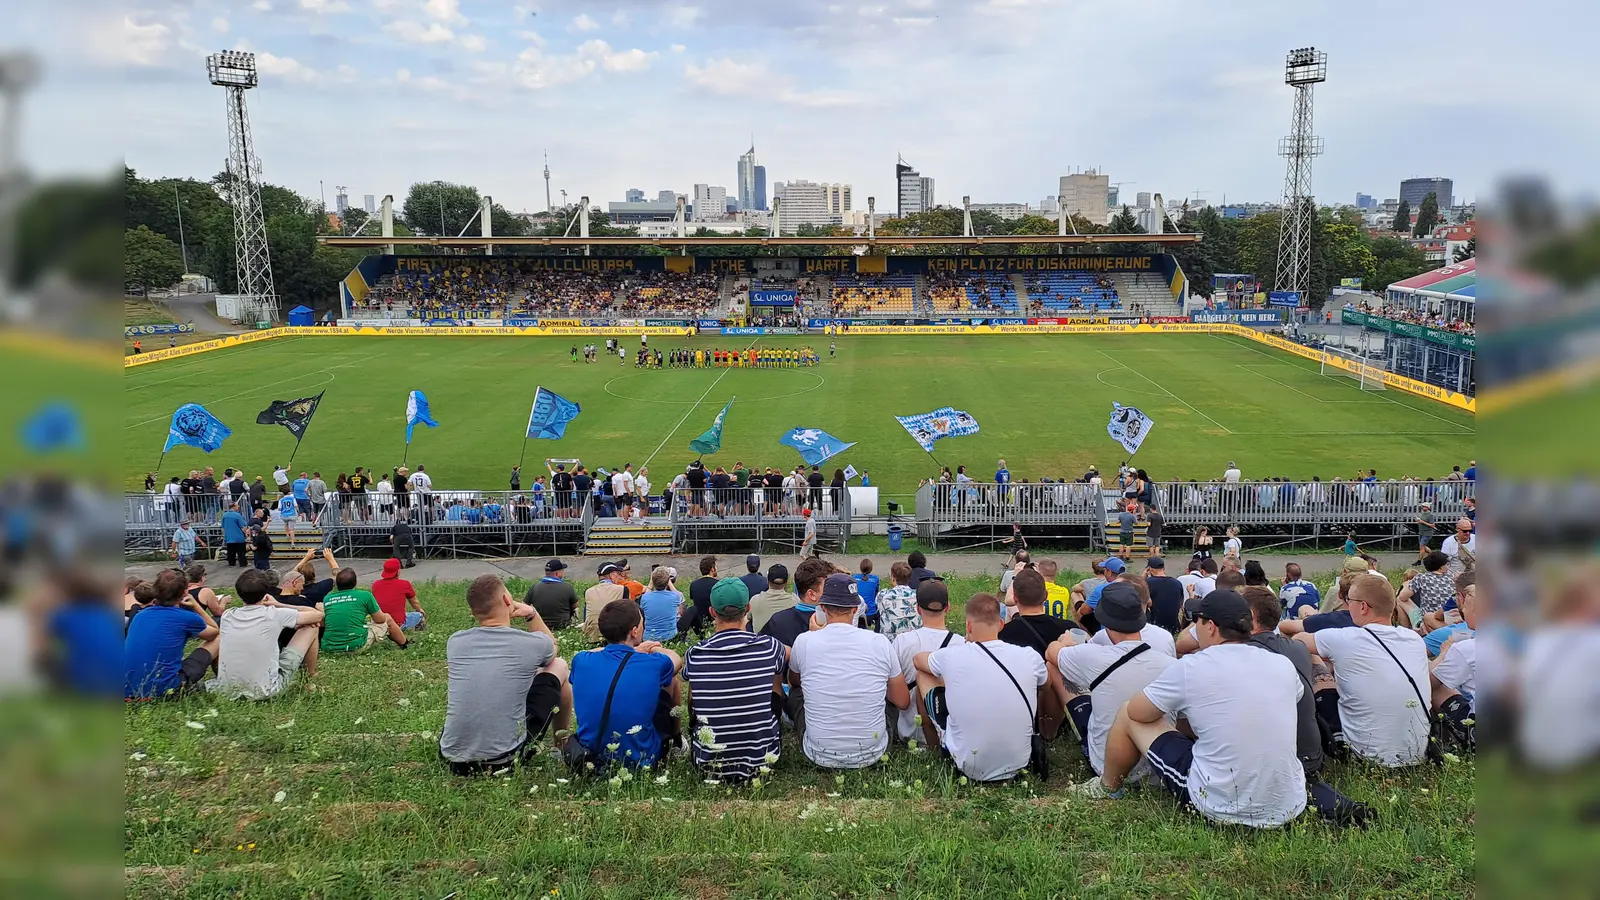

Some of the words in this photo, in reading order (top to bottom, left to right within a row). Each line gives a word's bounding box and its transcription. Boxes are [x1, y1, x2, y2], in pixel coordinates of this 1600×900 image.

[564, 259, 600, 272] CLUB
[602, 259, 634, 271] 1894
[928, 258, 958, 270] KEIN
[961, 258, 1004, 270] PLATZ
[1038, 256, 1151, 270] DISKRIMINIERUNG
[766, 294, 794, 302] UNIQA
[1390, 374, 1400, 384] Alles
[352, 480, 361, 488] 12
[415, 478, 423, 486] 13
